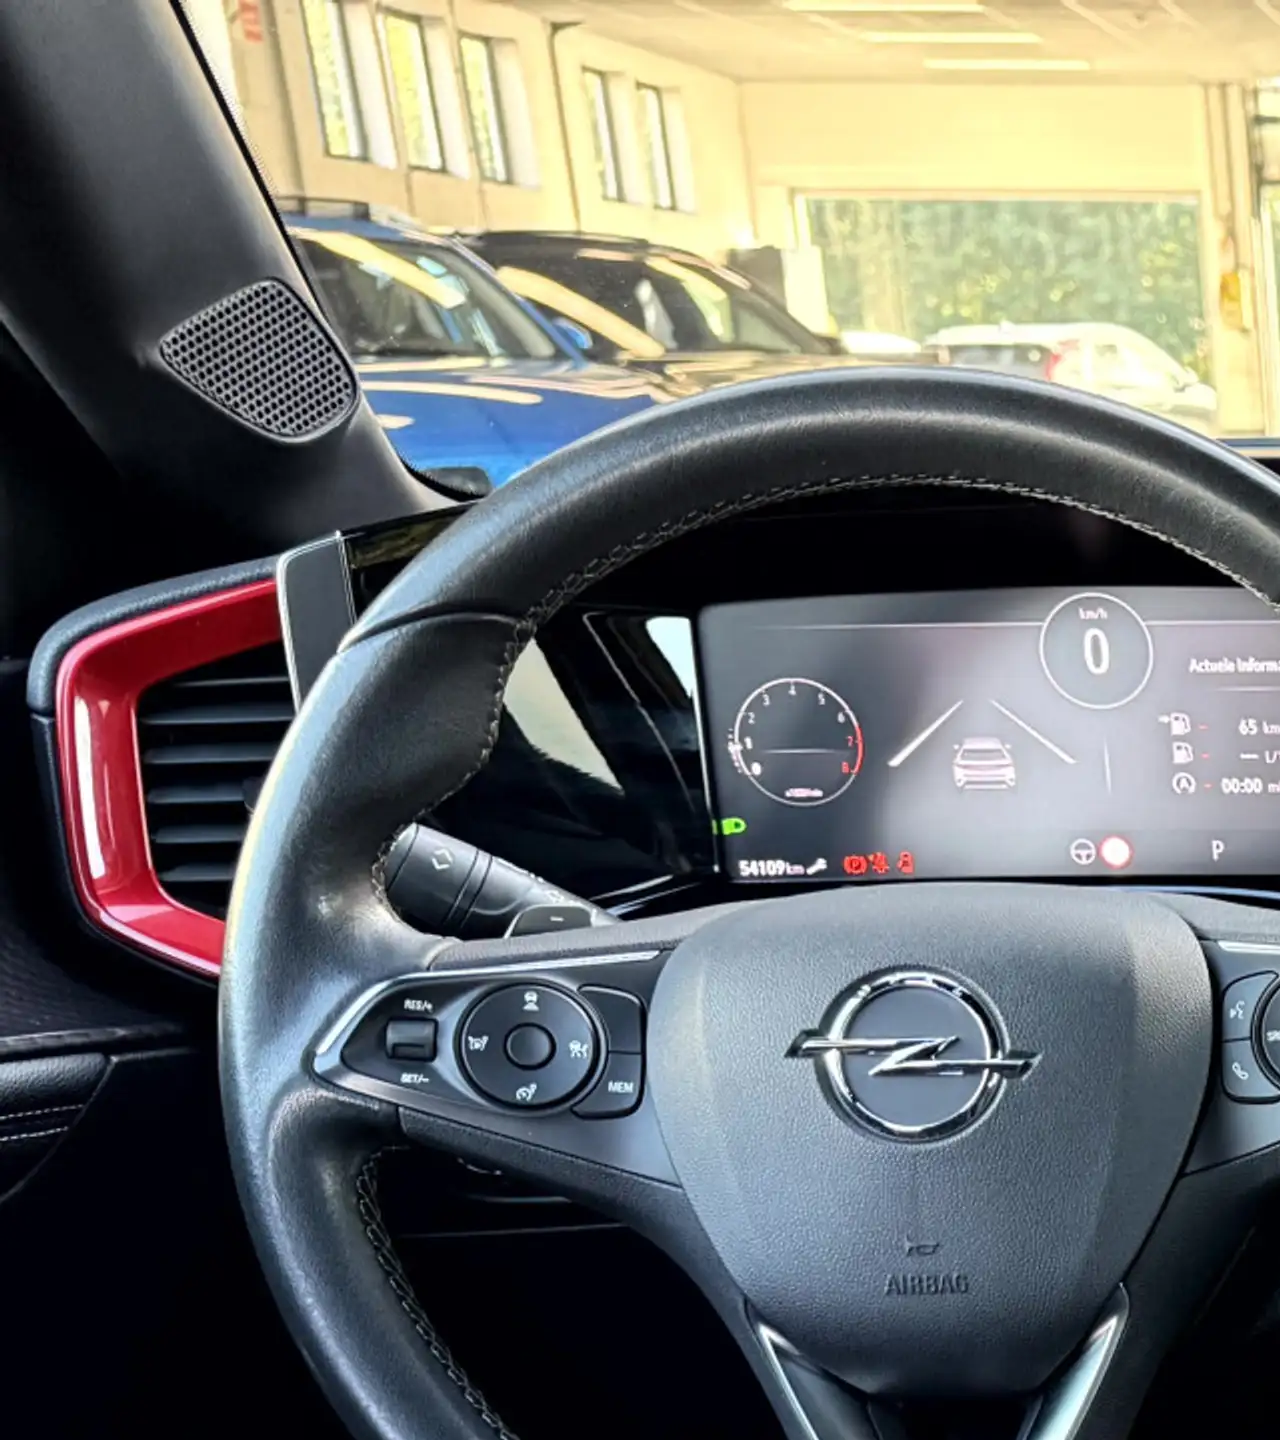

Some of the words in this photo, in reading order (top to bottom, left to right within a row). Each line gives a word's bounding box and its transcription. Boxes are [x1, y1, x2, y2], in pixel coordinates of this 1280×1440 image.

[1079, 607, 1108, 620] km/h
[1084, 628, 1110, 675] 0
[1189, 657, 1235, 673] Actuele
[1239, 720, 1258, 735] 65
[1221, 777, 1263, 794] 00:00
[1211, 841, 1225, 860] P
[738, 859, 786, 876] 54109
[608, 1081, 634, 1094] MEM
[884, 1273, 969, 1296] AIRBAG
